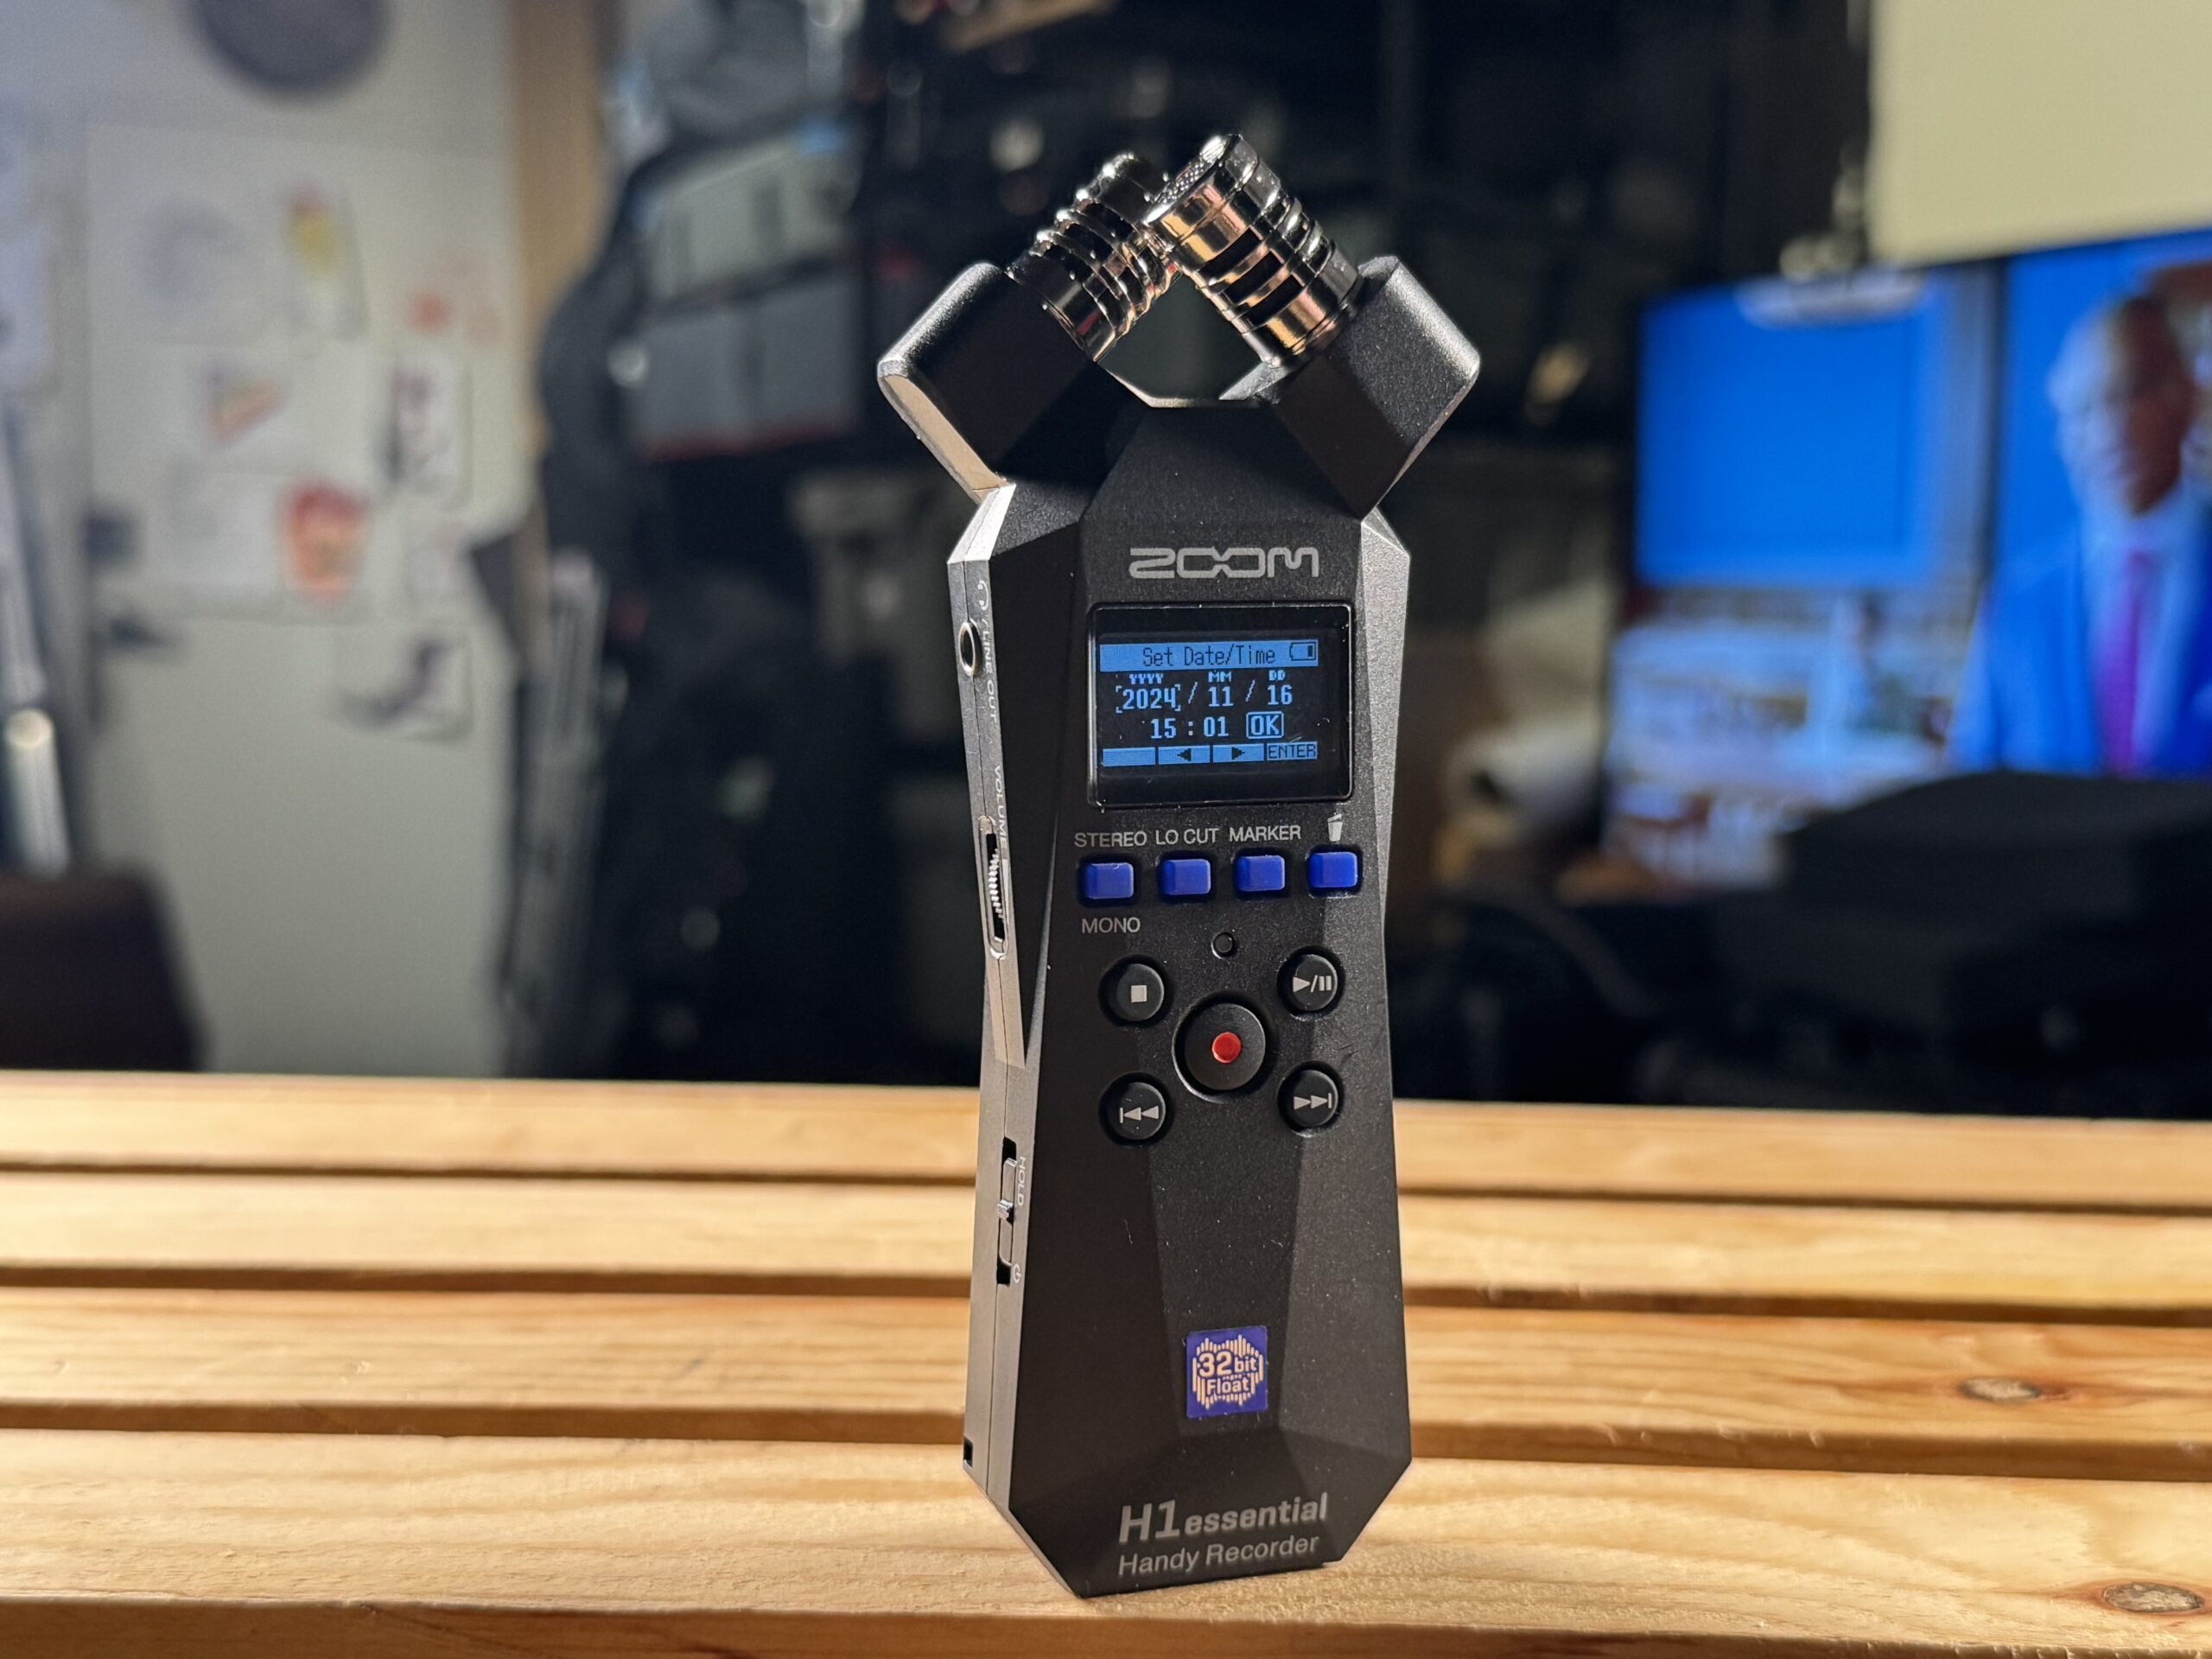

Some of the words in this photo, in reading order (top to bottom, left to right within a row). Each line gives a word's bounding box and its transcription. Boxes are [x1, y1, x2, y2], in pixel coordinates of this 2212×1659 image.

[1128, 547, 1319, 579] ZOOM
[983, 631, 994, 674] LINE
[1142, 648, 1173, 668] Set
[1184, 645, 1276, 667] Date/Time
[1129, 673, 1164, 685] YYYY
[1208, 670, 1232, 683] MM
[1268, 670, 1286, 682] DD
[987, 679, 997, 723] OUT
[1122, 688, 1178, 710] 2024
[1208, 685, 1234, 707] 11
[1267, 684, 1294, 706] 16
[1250, 715, 1281, 735] OK
[1268, 744, 1317, 760] ENTER
[994, 765, 1008, 849] VOLUME
[1074, 830, 1147, 848] STEREO
[1155, 829, 1179, 846] LO
[1183, 827, 1219, 844] CUT
[1229, 824, 1301, 843] MARKER
[1082, 917, 1141, 934] MONO
[1017, 1156, 1027, 1207] HOLD
[1206, 1376, 1249, 1395] Float
[1118, 1548, 1199, 1576] Handy
[1205, 1534, 1319, 1565] Recorder
